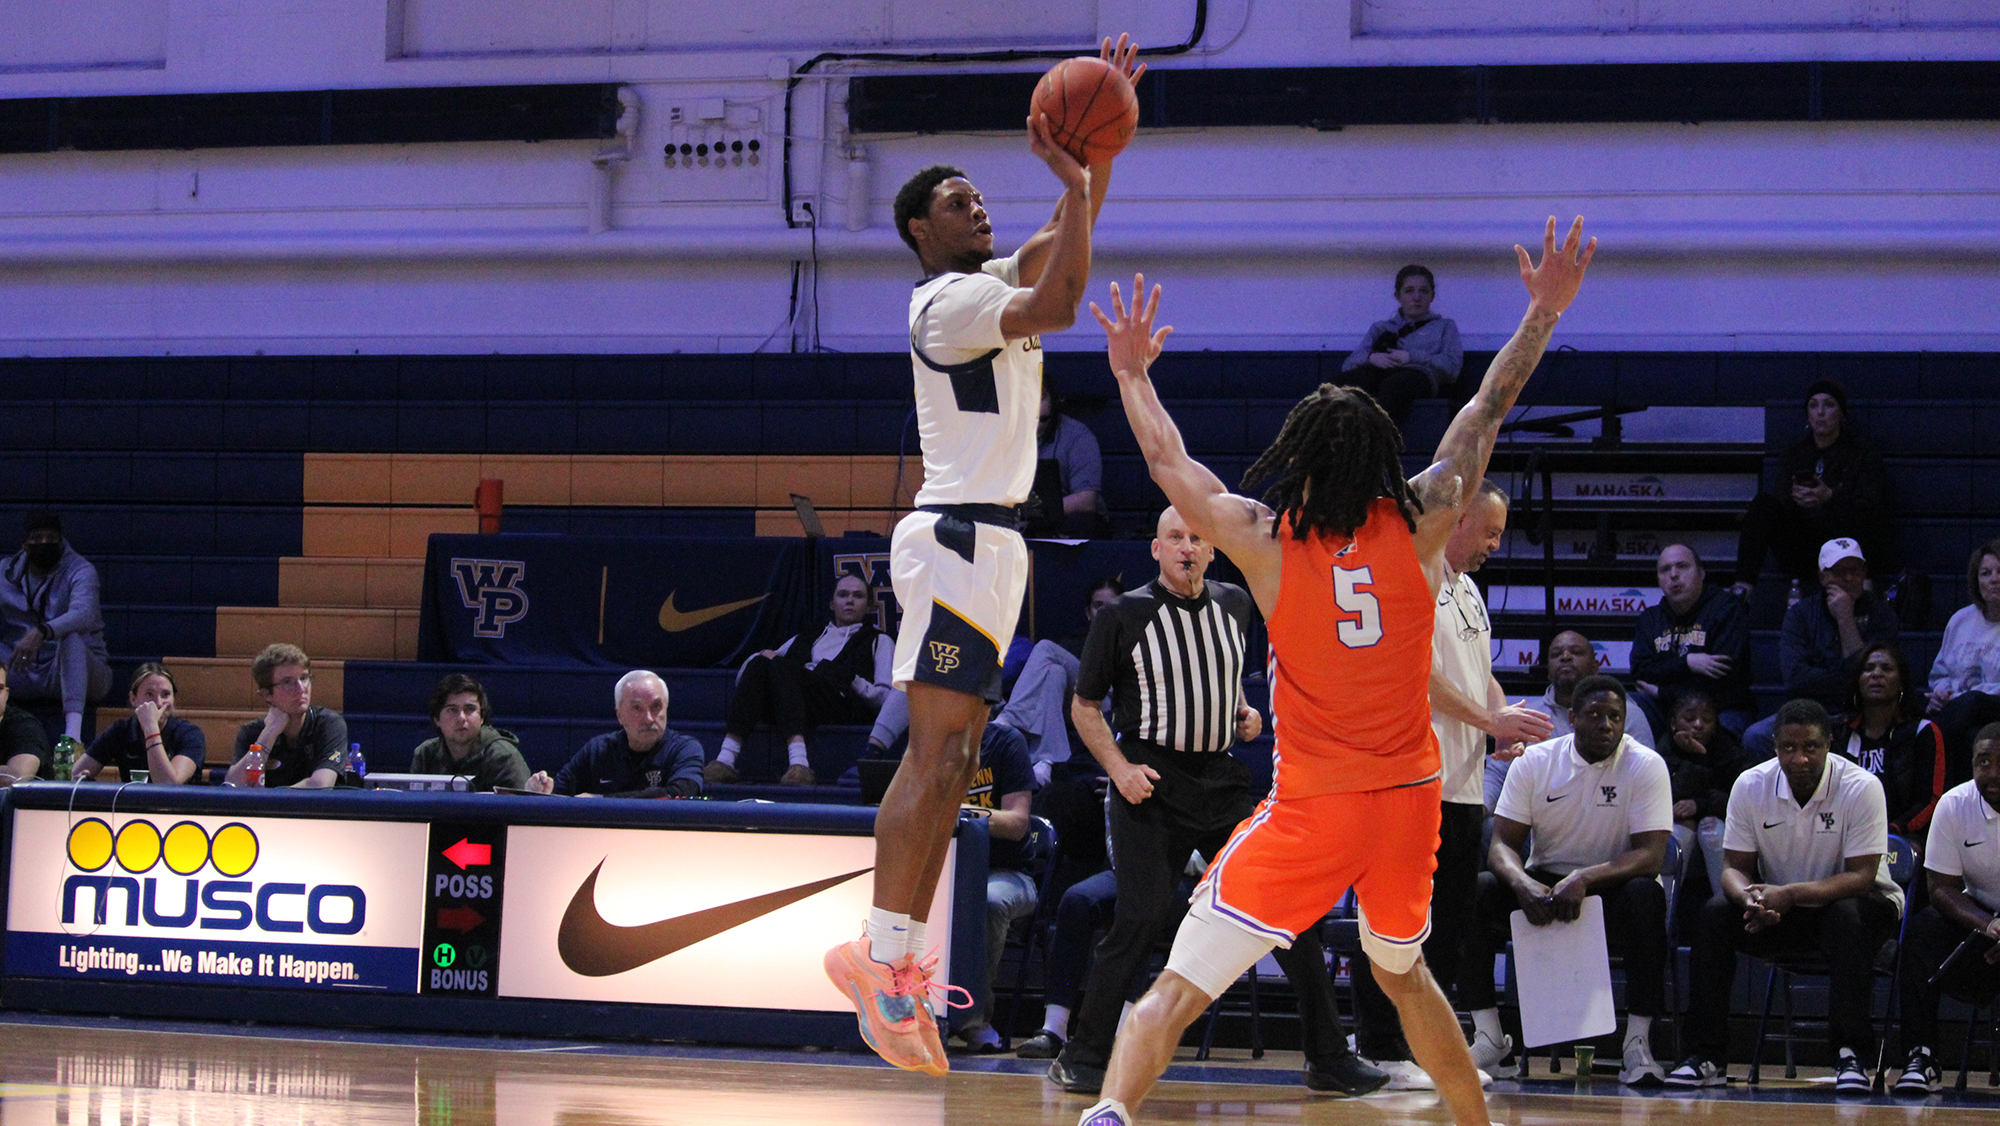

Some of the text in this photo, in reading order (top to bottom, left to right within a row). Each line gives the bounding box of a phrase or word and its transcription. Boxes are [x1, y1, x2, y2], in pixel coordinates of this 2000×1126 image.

[1576, 484, 1664, 496] MAHASKA
[1572, 541, 1661, 555] MASKA
[451, 557, 529, 638] WP
[1331, 564, 1384, 650] 5
[1558, 597, 1647, 611] MAHASKA
[929, 641, 960, 674] WP
[1601, 785, 1617, 803] WP
[1819, 812, 1835, 830] WP
[434, 873, 494, 899] POSS
[197, 950, 254, 976] Make
[258, 953, 275, 977] It
[437, 946, 453, 964] H
[430, 968, 489, 992] BONUS
